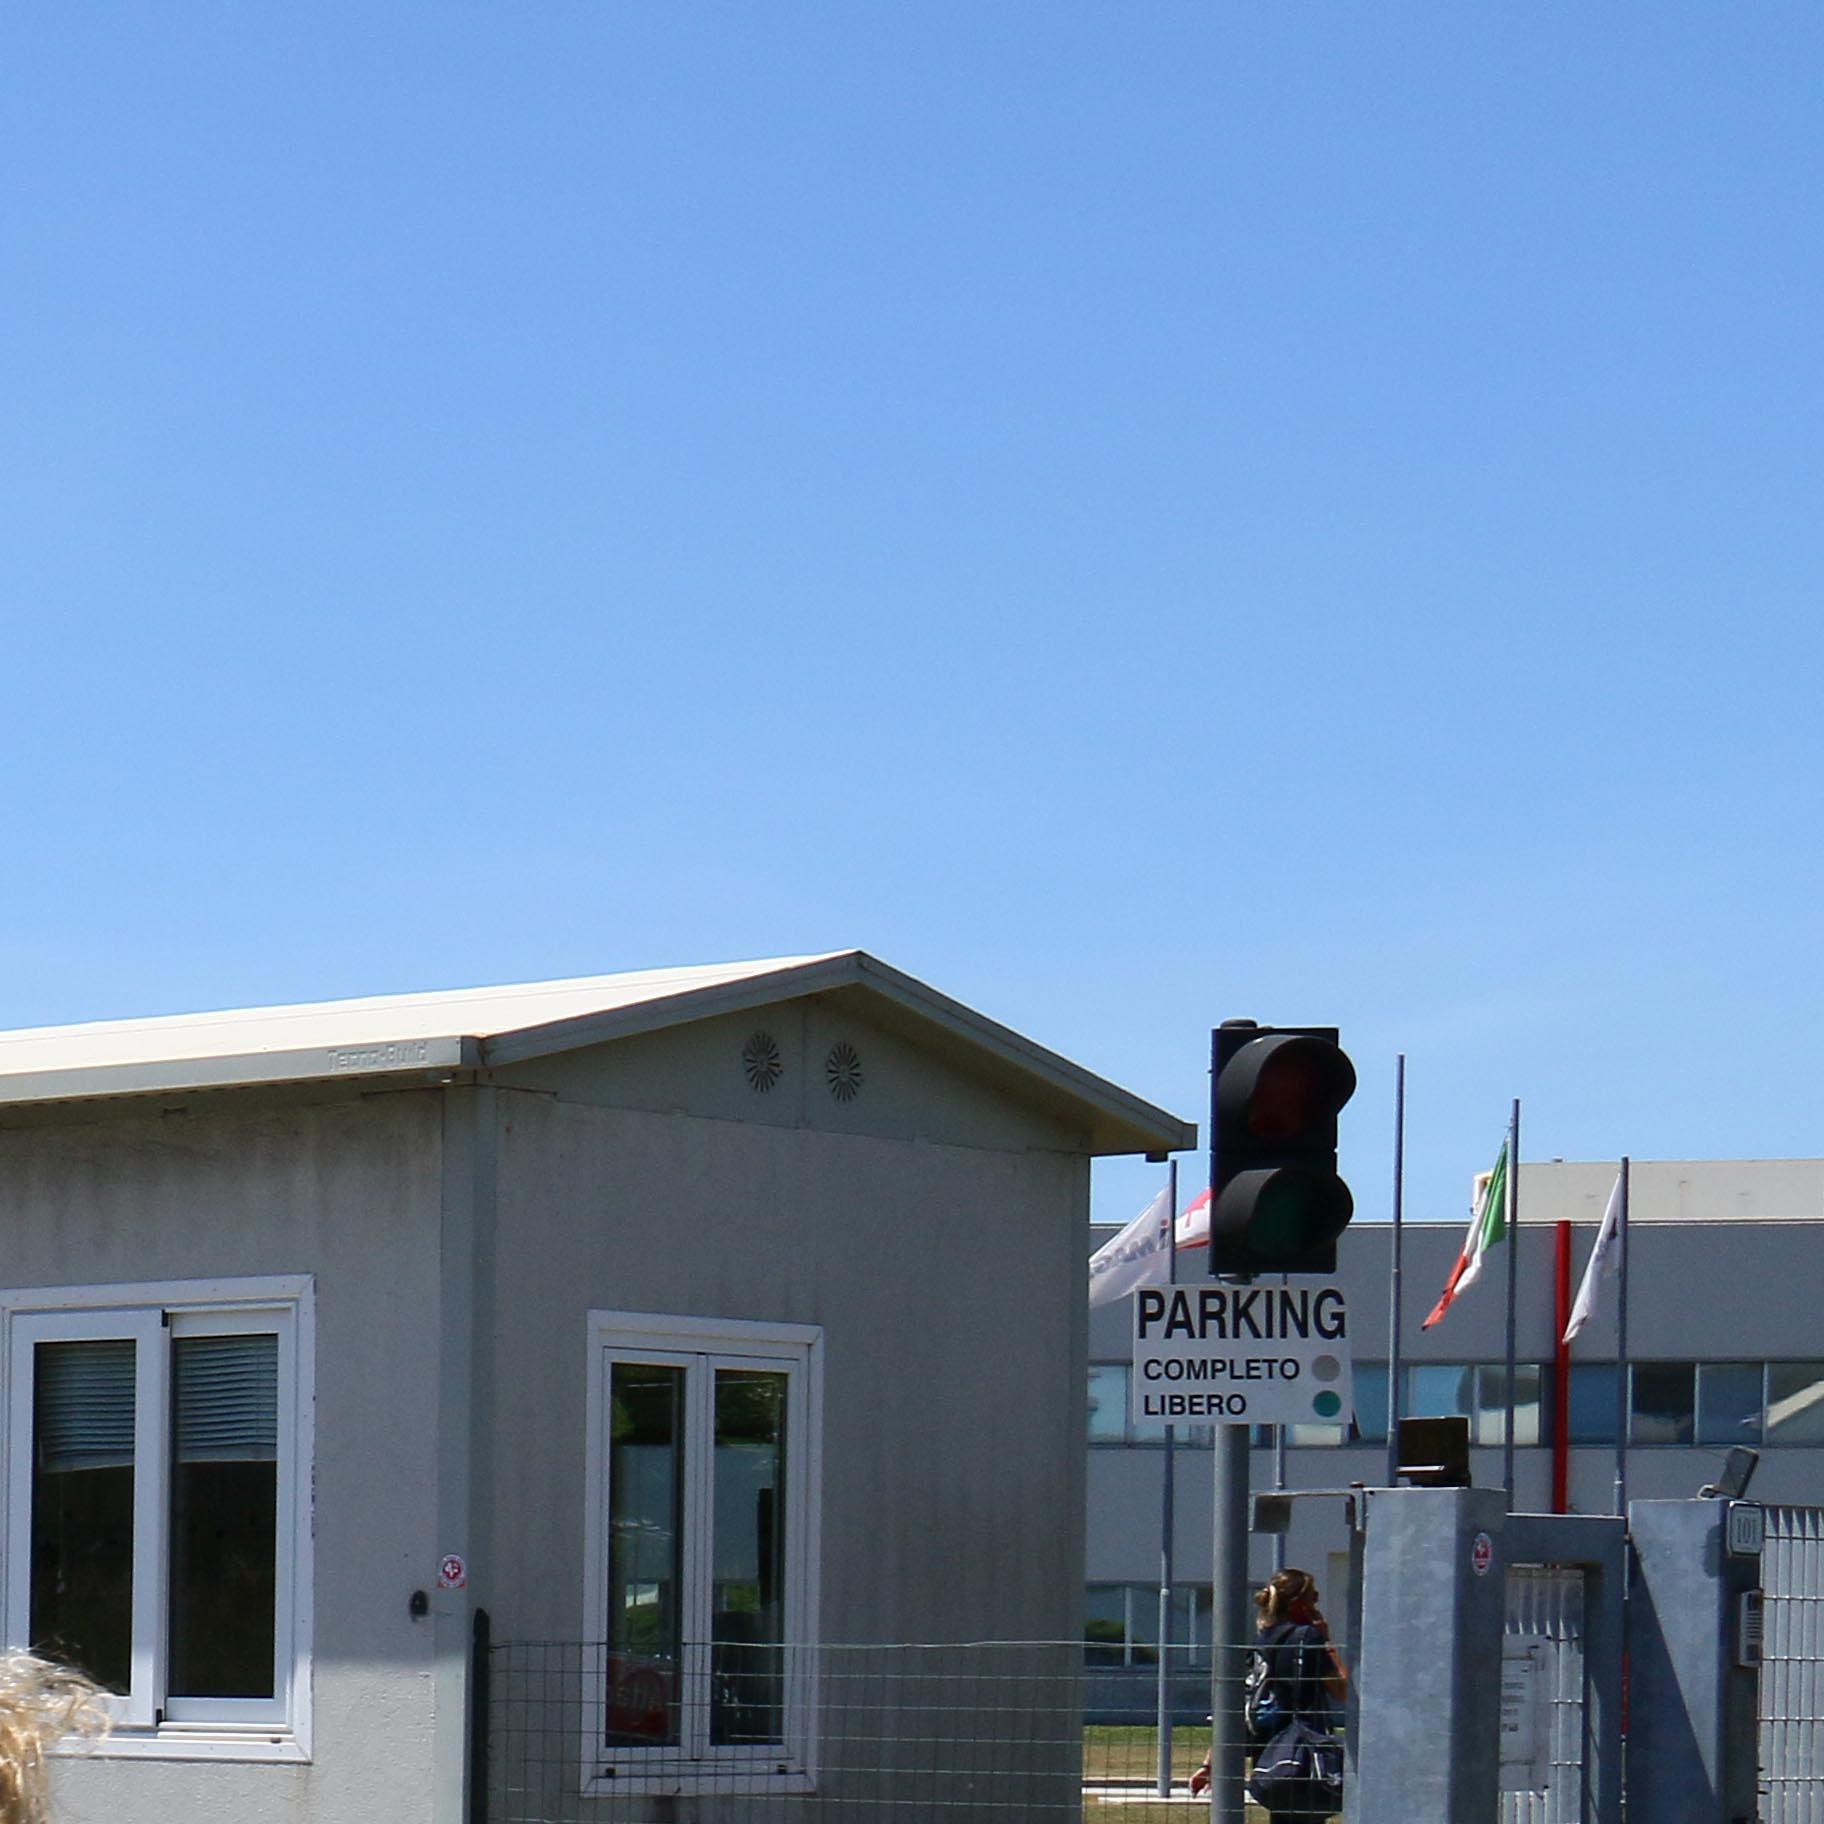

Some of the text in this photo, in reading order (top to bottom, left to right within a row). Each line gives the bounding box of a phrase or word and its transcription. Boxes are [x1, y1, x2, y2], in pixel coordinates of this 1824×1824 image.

[1137, 1288, 1347, 1340] PARKING
[1143, 1357, 1301, 1382] COMPLETO
[1143, 1393, 1248, 1417] LIBERO
